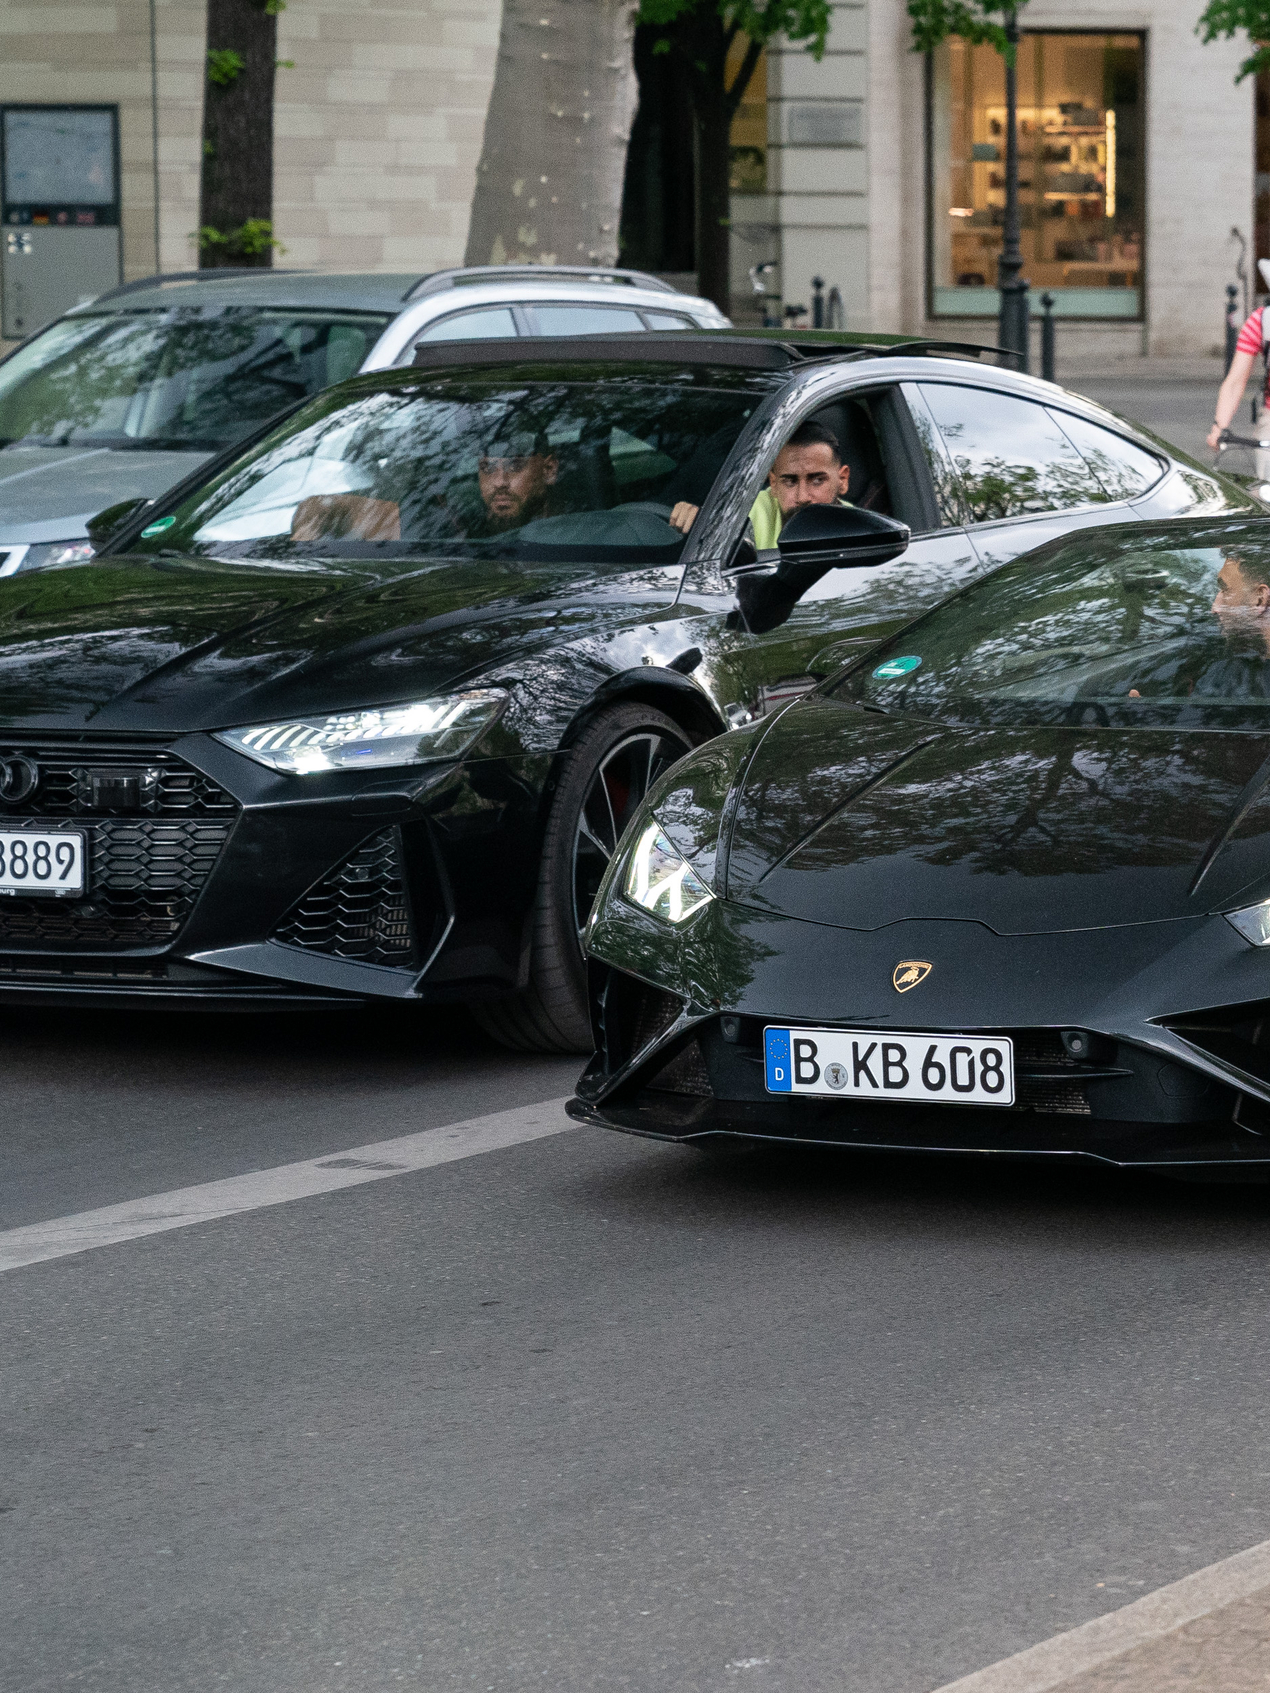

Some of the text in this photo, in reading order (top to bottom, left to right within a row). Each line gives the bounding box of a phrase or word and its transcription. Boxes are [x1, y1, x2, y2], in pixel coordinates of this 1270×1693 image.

[0, 839, 75, 881] 889
[774, 1066, 785, 1082] D
[793, 1038, 821, 1085] B
[852, 1041, 910, 1090] KB
[921, 1044, 1005, 1094] 608
